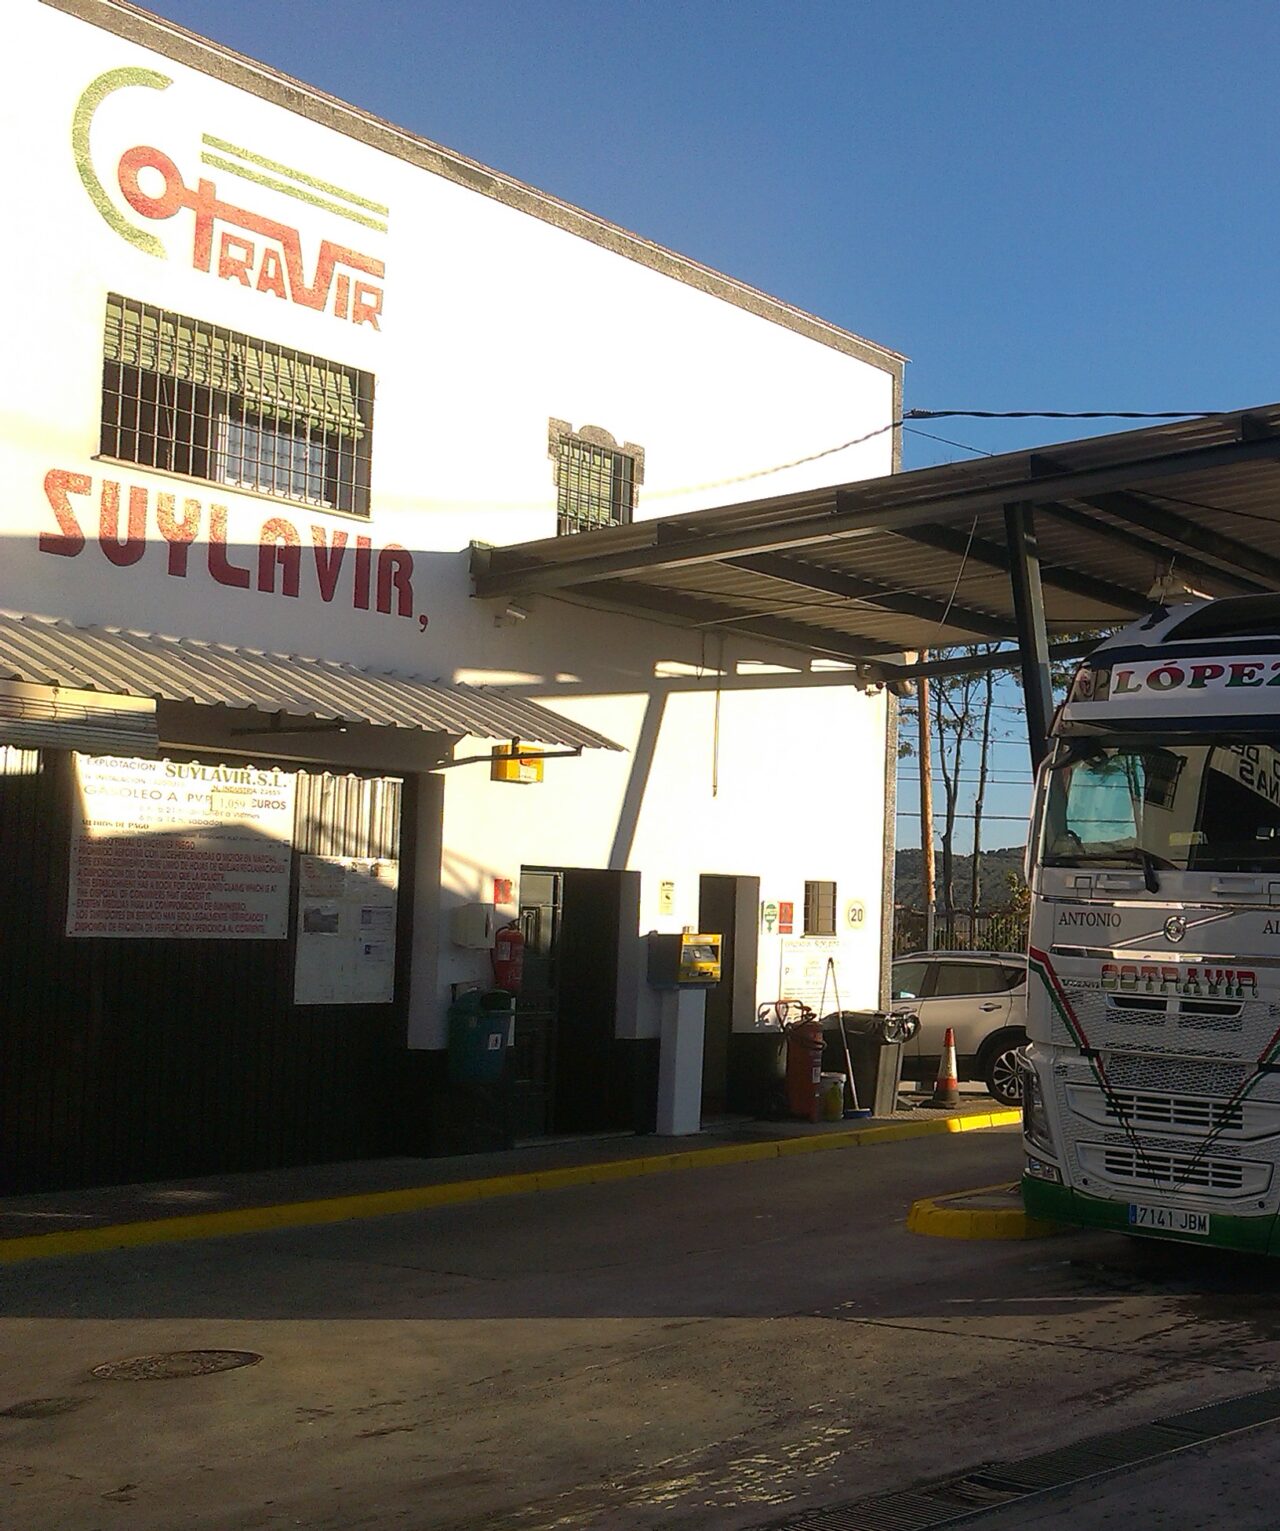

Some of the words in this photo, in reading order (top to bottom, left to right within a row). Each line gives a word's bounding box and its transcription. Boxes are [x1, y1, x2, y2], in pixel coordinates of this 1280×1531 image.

[167, 792, 178, 801] A
[851, 908, 863, 922] 20
[1058, 911, 1121, 928] ANTONIO
[1140, 1208, 1173, 1227] 7141
[1180, 1213, 1207, 1232] JBM
